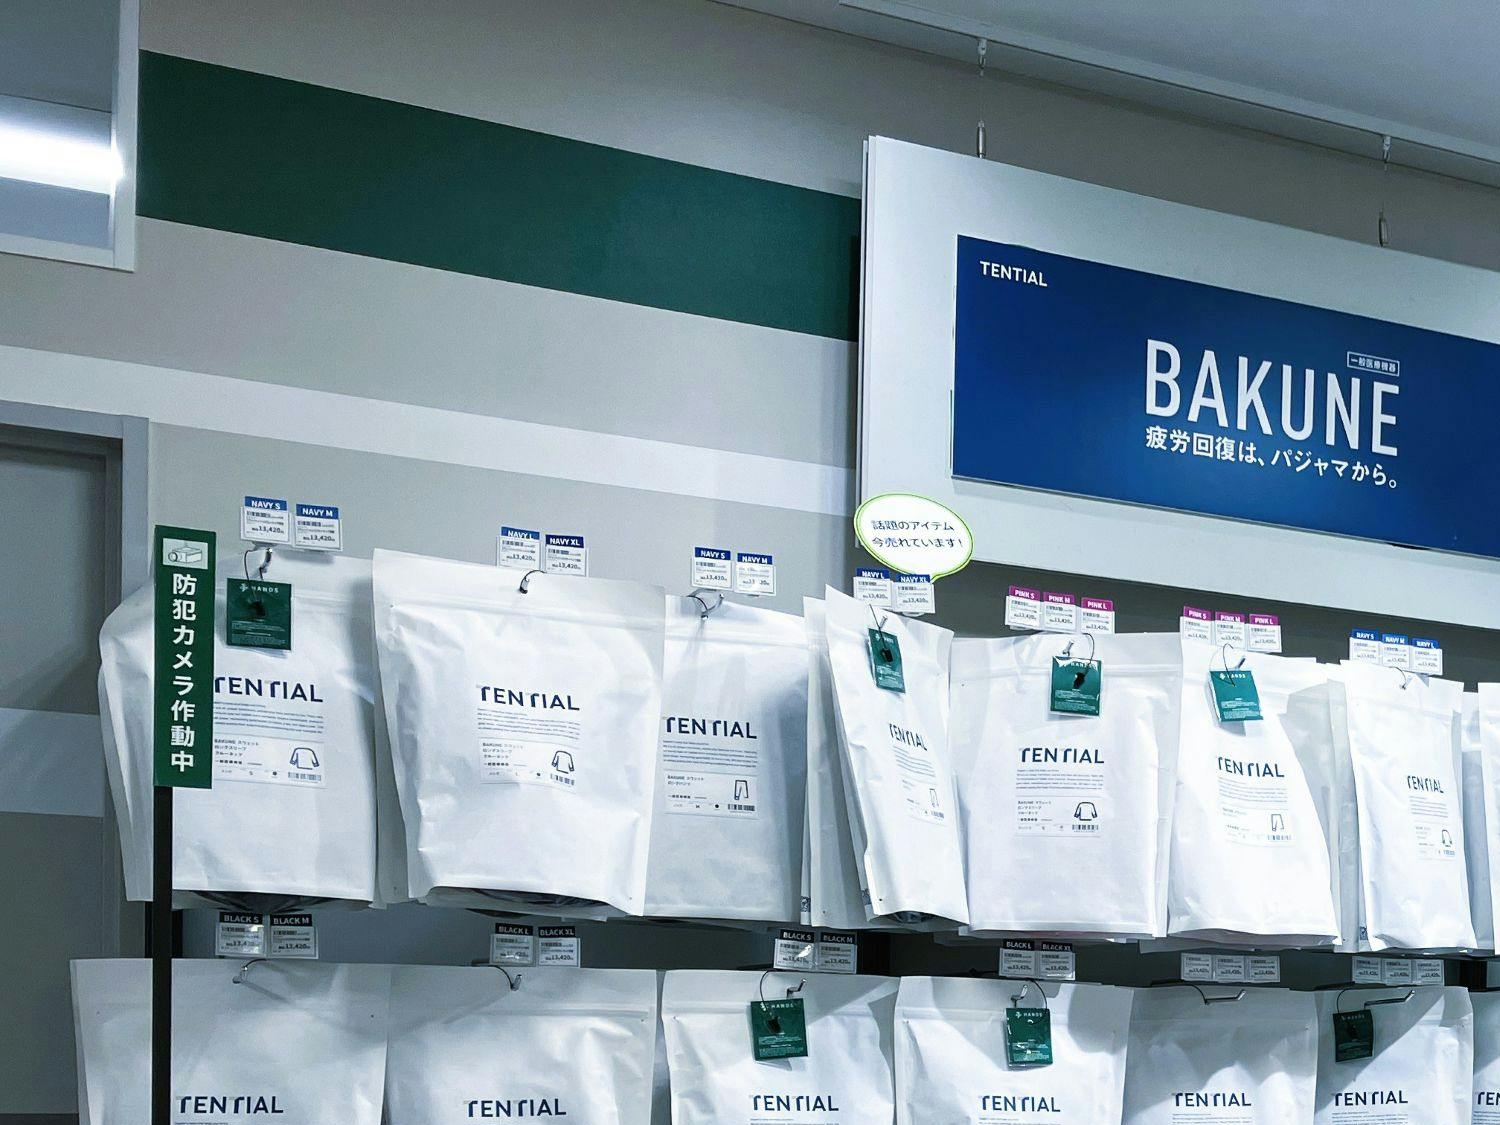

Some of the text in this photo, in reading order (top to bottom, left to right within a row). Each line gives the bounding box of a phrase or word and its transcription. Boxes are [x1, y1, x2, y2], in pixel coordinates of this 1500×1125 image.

[980, 260, 1047, 287] TENTIAL
[1144, 338, 1400, 457] BAKUNE
[1144, 424, 1398, 490] 疲労回復は、パジャマから。
[251, 500, 272, 509] NAVY
[302, 507, 325, 516] NAVY
[871, 519, 954, 532] 話題のアイテム
[550, 537, 571, 545] NAVY
[700, 550, 720, 559] NAVY
[742, 555, 762, 563] NAVY
[862, 570, 879, 578] NAVY
[1014, 589, 1029, 598] PINK
[1087, 600, 1102, 608] PINK
[170, 573, 198, 773] 防犯カメラ作動中
[215, 677, 323, 702] TENTIAL
[481, 687, 579, 710] TENTIAL
[667, 717, 757, 739] TENTIAL
[889, 724, 927, 751] TENTIAL
[1022, 748, 1104, 763] TENTIAL
[1218, 757, 1284, 777] TENTIAL
[1407, 775, 1444, 793] TENTIAL
[224, 914, 250, 923] BLACK
[274, 916, 301, 925] BLACK
[498, 926, 523, 935] BLACK
[539, 928, 564, 936] BLACK
[783, 931, 805, 940] BLACK
[823, 934, 847, 943] BLACK
[181, 1096, 283, 1114] TENTIAL
[754, 1095, 839, 1111] TENTIAL
[983, 1096, 1060, 1112] TENTIAL
[1175, 1092, 1251, 1107] TENTIAL
[1334, 1091, 1408, 1107] TENTIAL
[469, 1099, 566, 1117] TENTIAL
